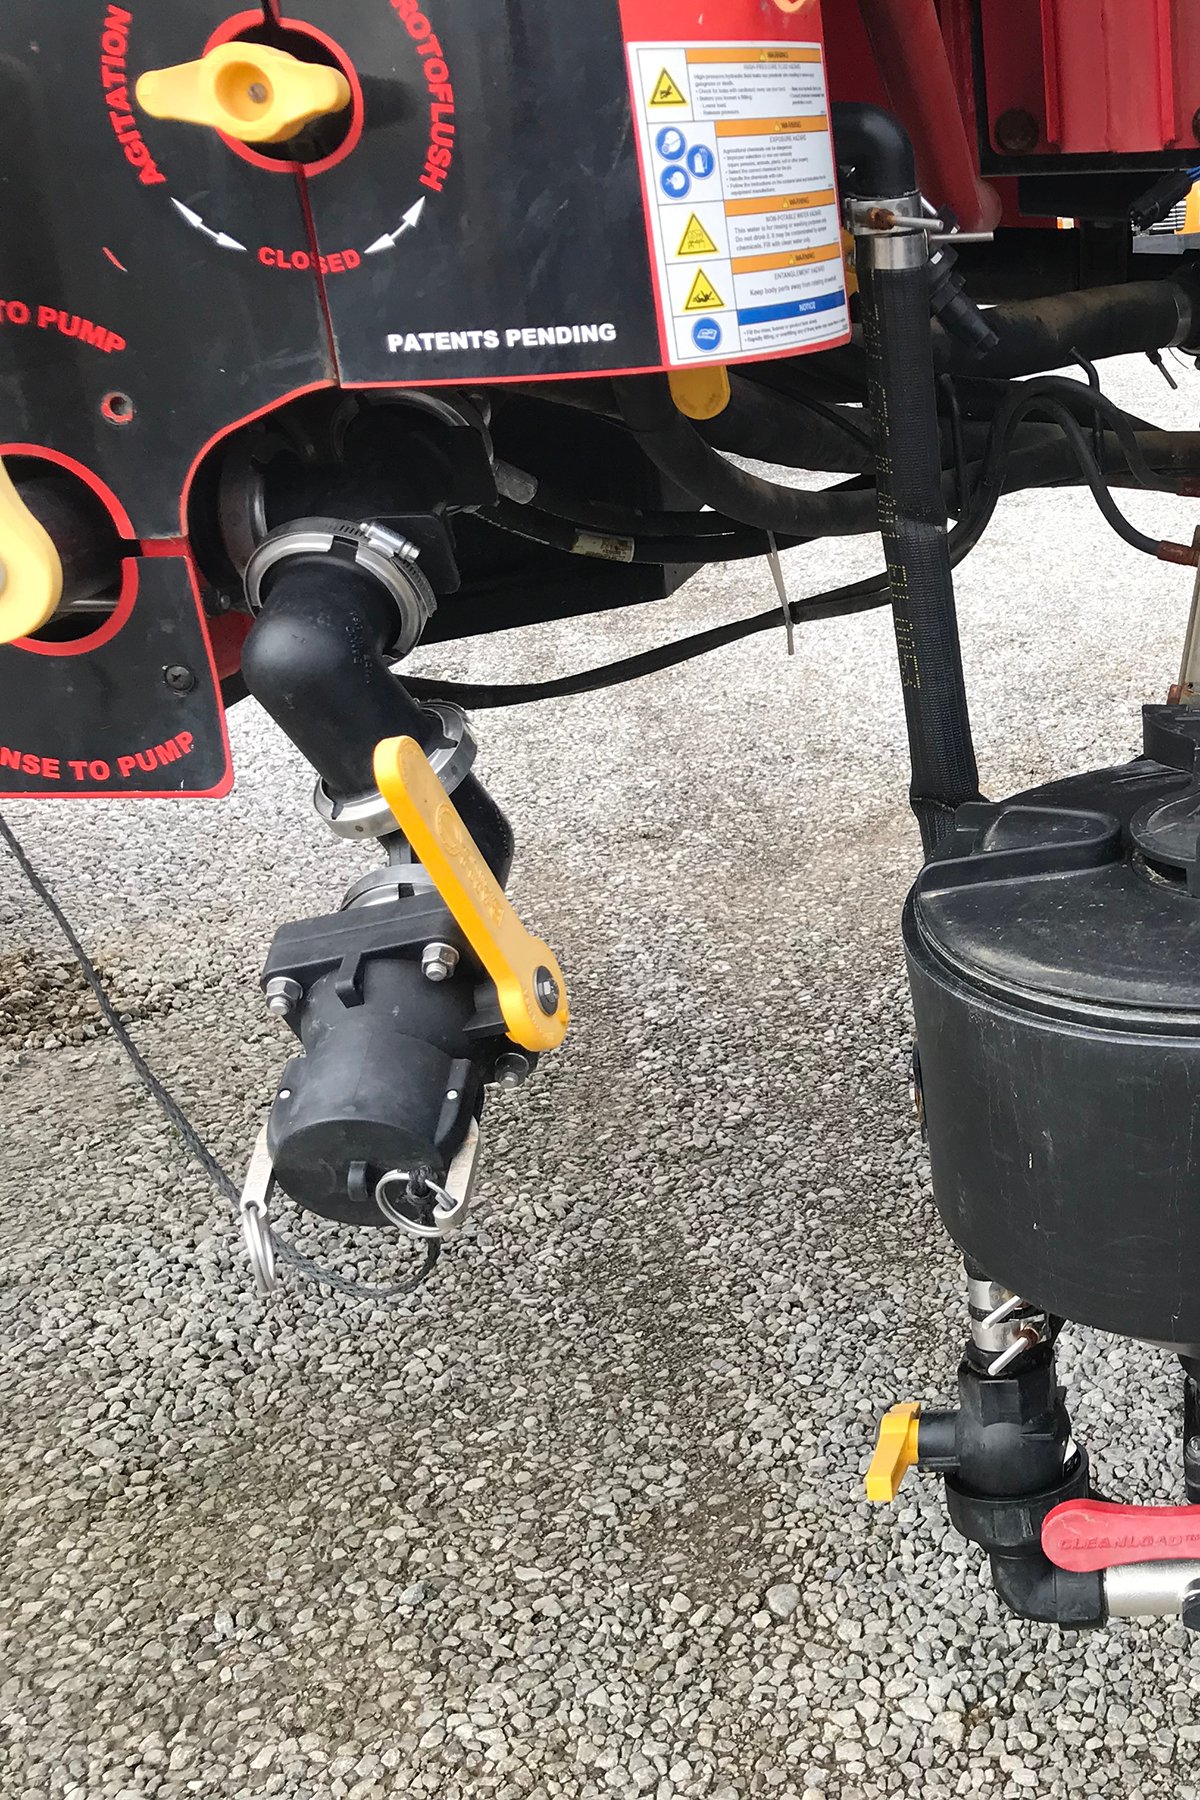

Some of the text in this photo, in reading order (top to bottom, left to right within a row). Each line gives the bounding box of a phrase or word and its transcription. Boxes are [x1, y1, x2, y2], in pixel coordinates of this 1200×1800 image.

[102, 4, 167, 185] AGITATION
[258, 246, 361, 274] CLOSED
[38, 305, 127, 353] PUMP
[387, 323, 617, 353] PATENTS PENDING
[69, 760, 110, 781] TO
[117, 731, 194, 778] PUMP
